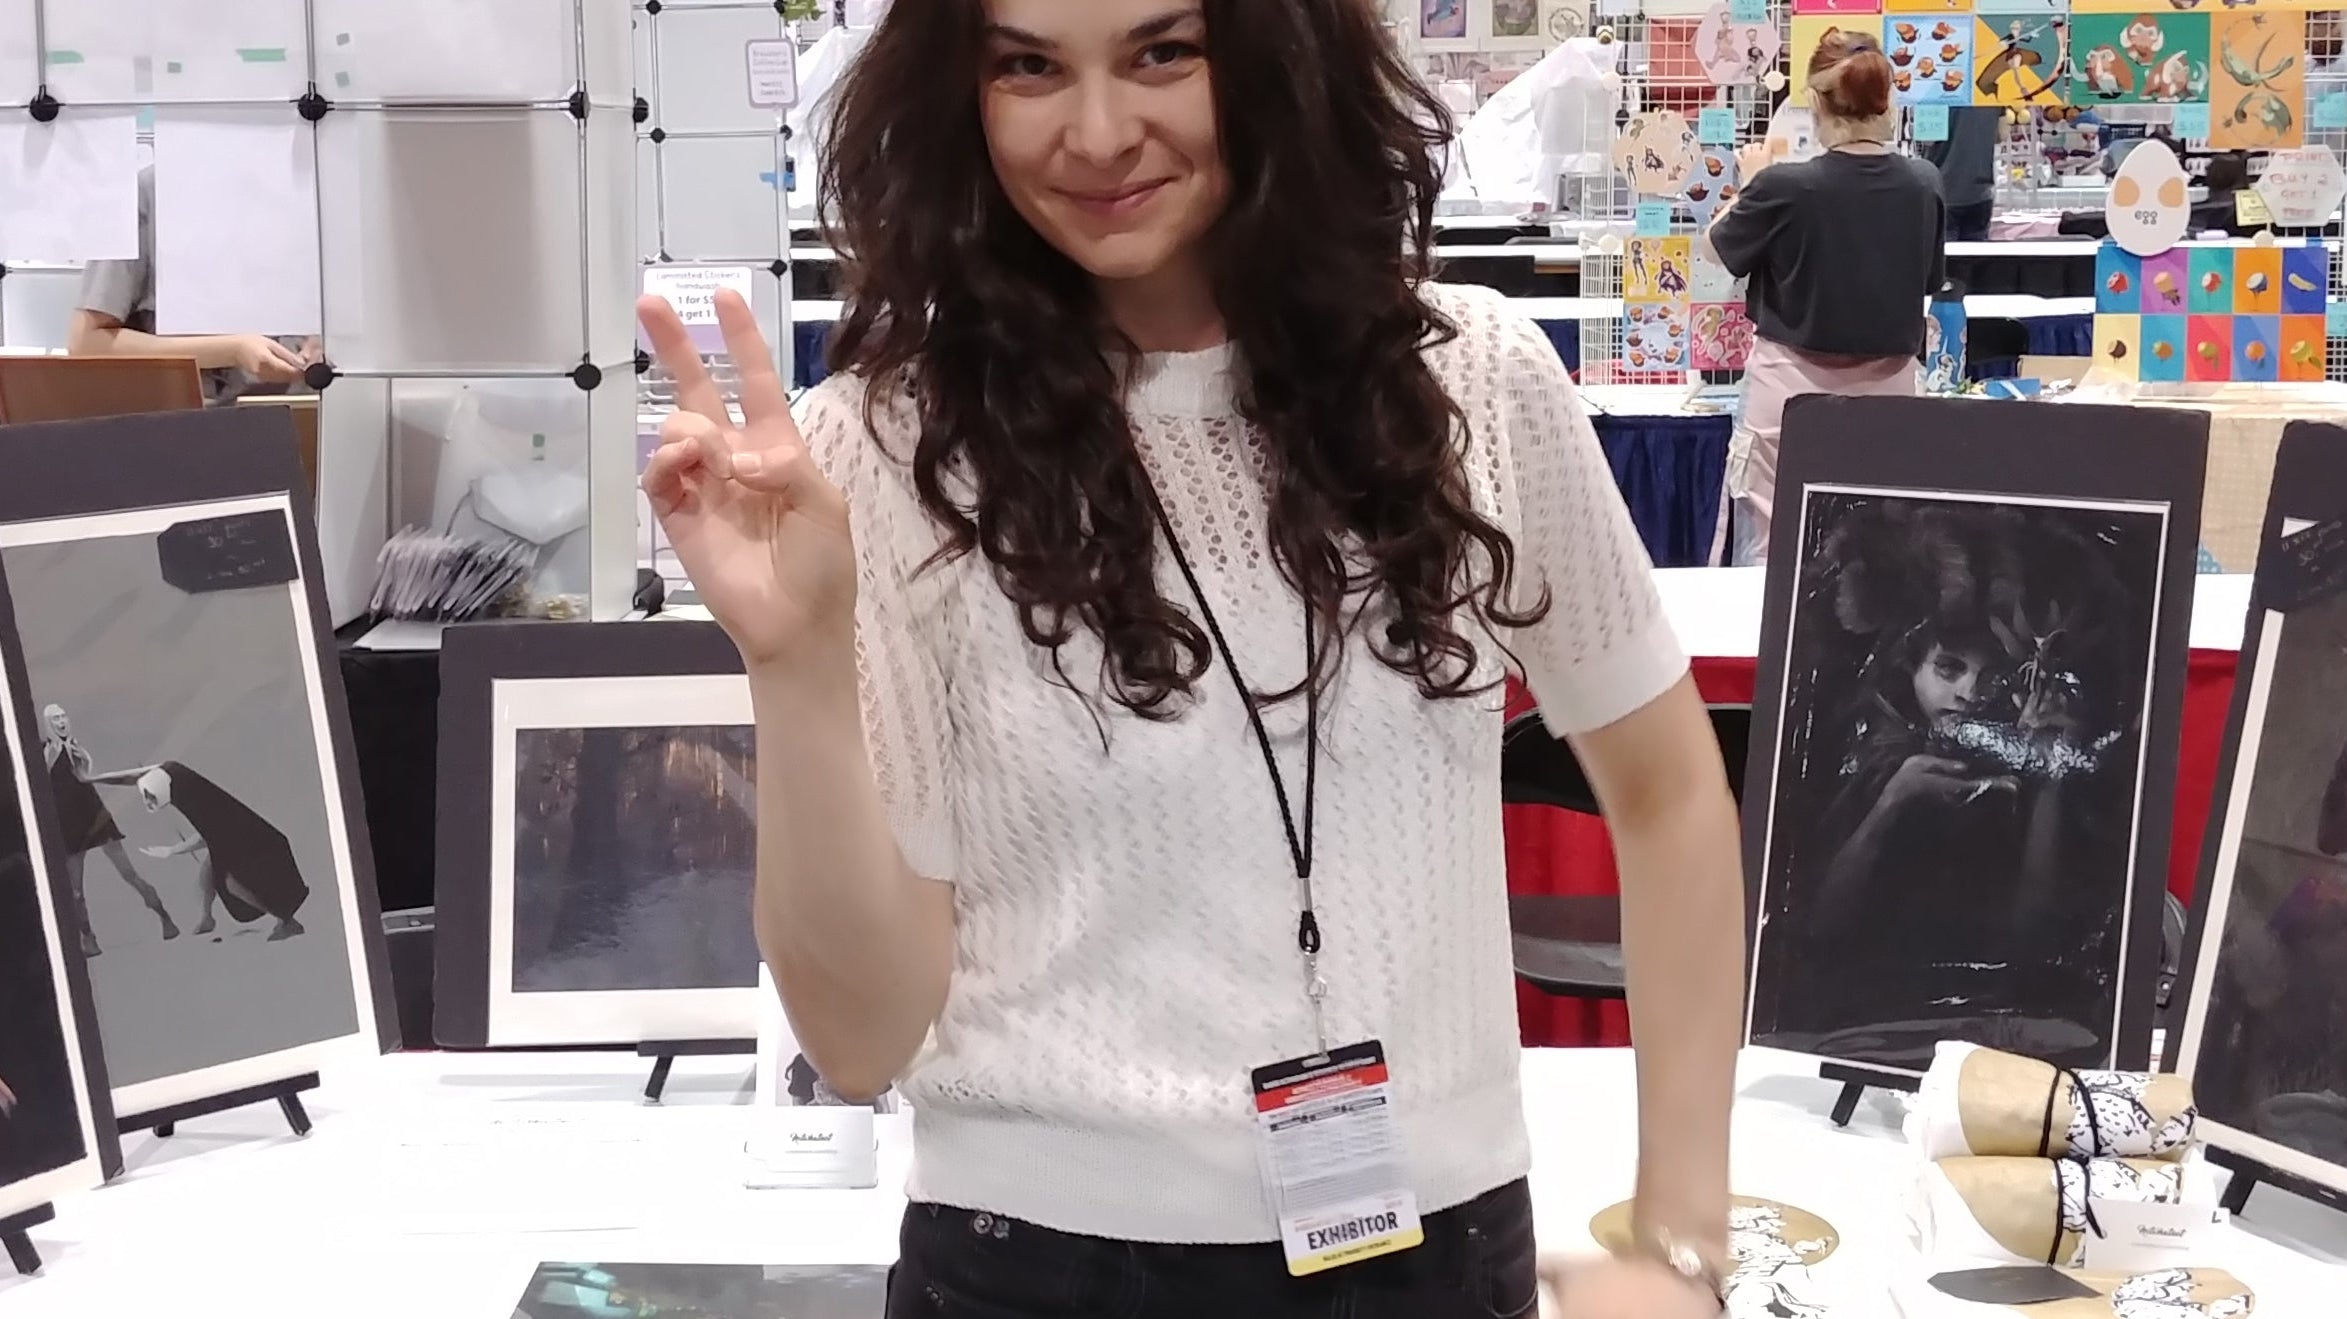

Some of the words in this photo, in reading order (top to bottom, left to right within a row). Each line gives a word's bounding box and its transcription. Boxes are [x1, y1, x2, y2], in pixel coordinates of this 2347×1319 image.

[2269, 172, 2307, 185] BUY
[2317, 173, 2328, 185] 2
[2134, 210, 2158, 225] egg
[678, 296, 683, 304] 1
[686, 295, 700, 304] for
[685, 310, 703, 320] get
[706, 309, 711, 318] 1
[1307, 1211, 1399, 1250] EXHIBITOR
